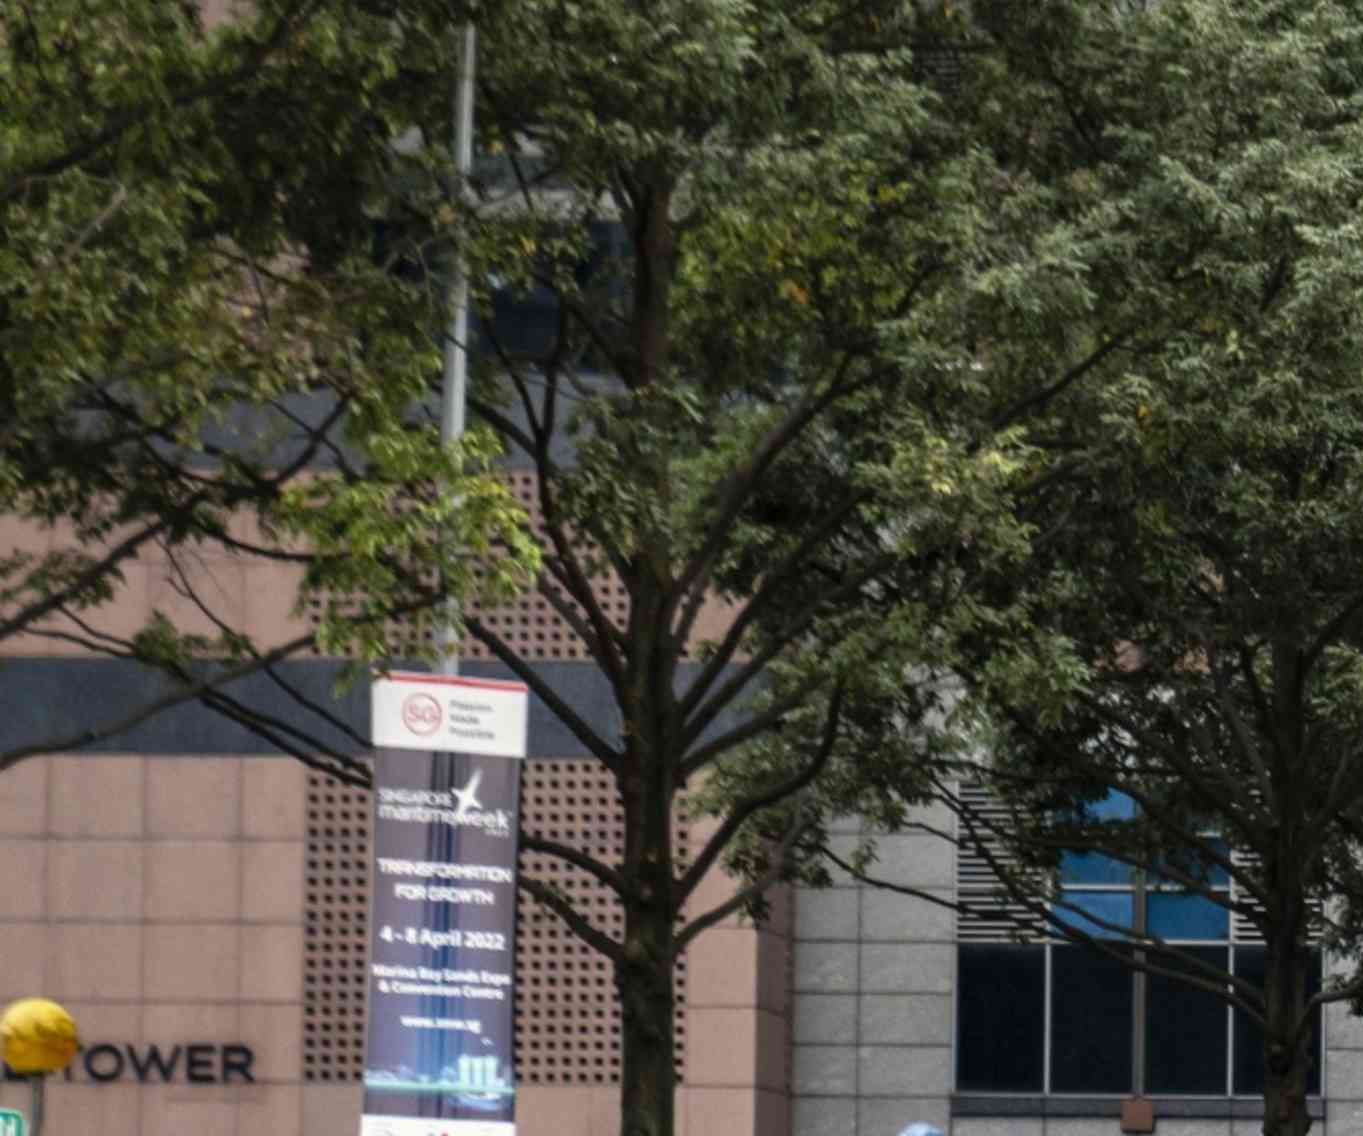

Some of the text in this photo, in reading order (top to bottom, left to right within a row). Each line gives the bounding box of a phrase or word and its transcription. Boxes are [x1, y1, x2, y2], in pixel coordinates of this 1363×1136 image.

[377, 857, 512, 883] TRANSFORMATION
[394, 884, 495, 905] FOR GROWTH
[380, 925, 393, 943] 4
[420, 928, 462, 949] April
[464, 931, 505, 951] 2022
